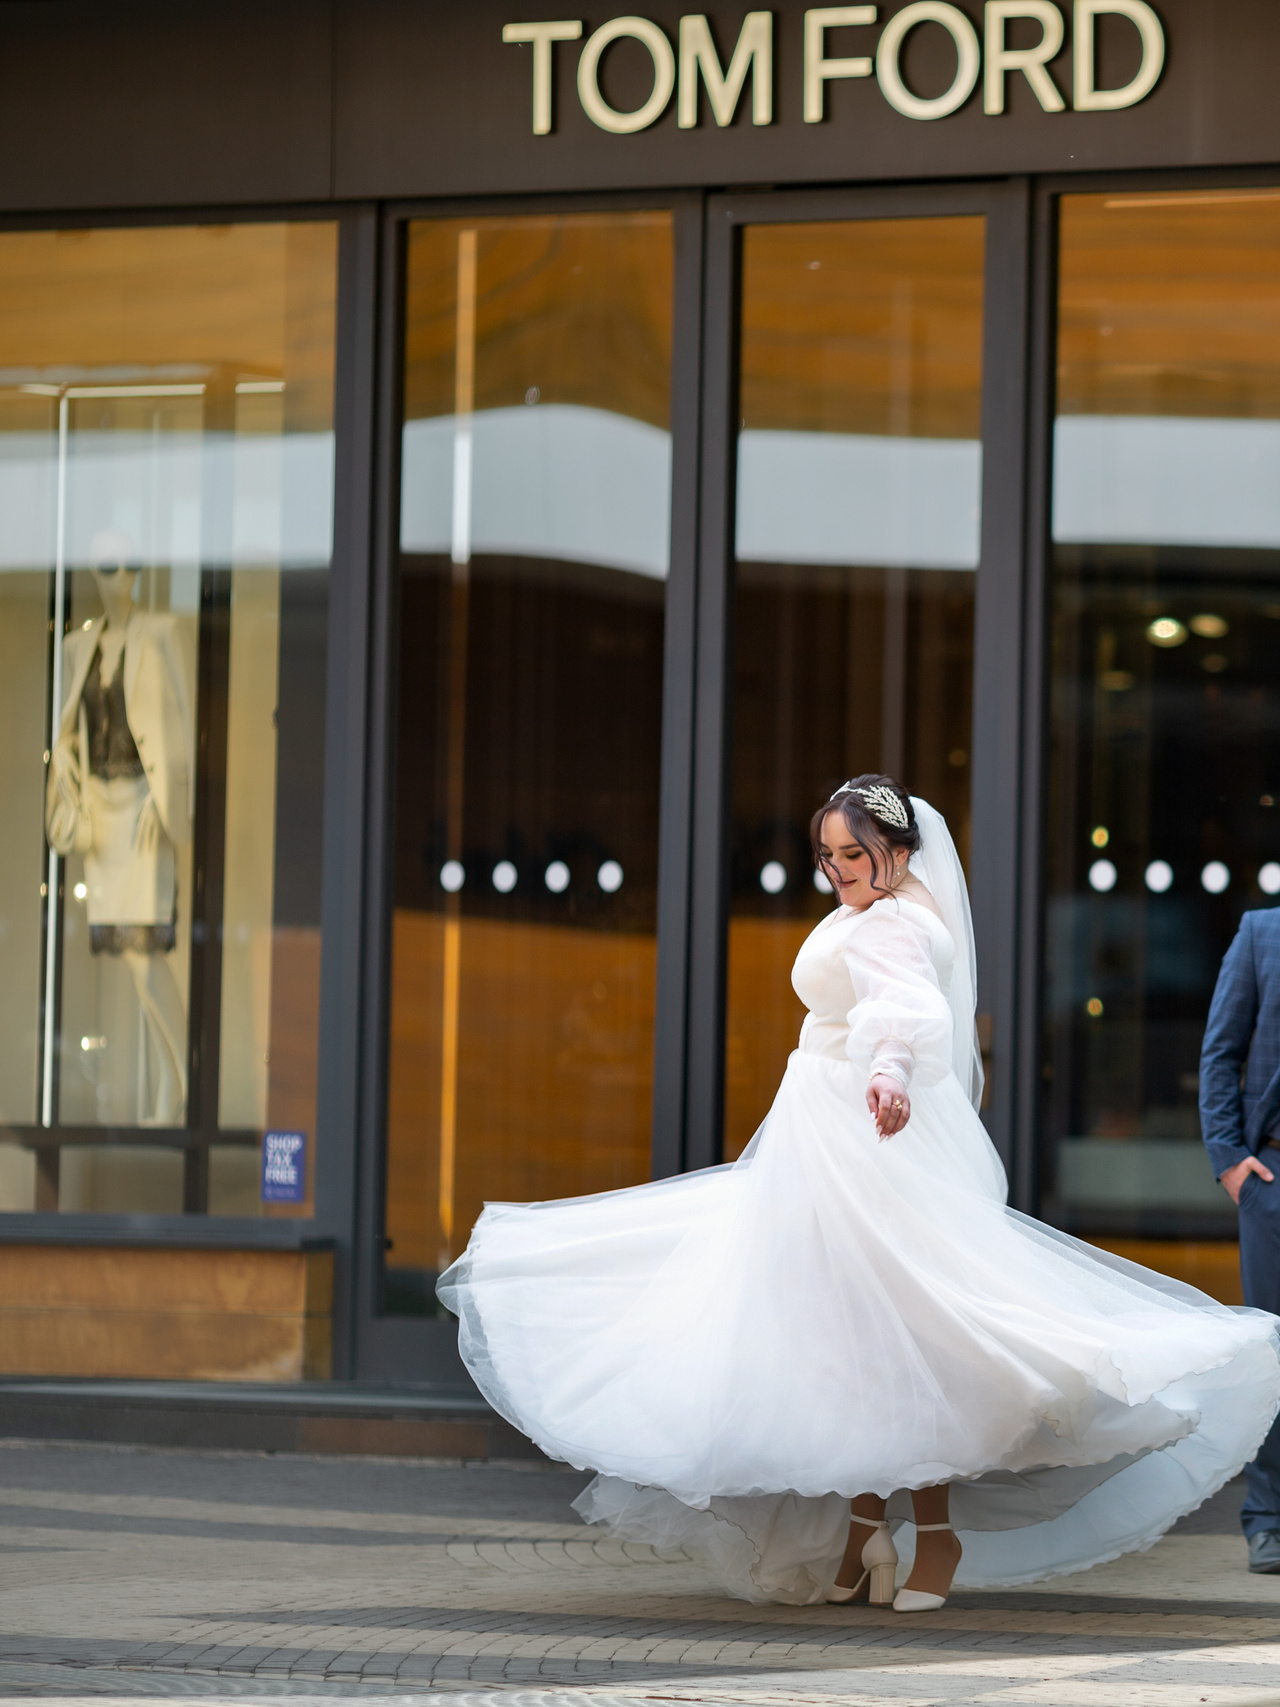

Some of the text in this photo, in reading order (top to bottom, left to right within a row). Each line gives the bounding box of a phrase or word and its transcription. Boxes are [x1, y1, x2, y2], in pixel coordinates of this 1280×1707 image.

[502, 0, 1166, 136] TOM FORD
[266, 1133, 303, 1153] SHOP
[266, 1150, 293, 1167] TAX
[265, 1166, 298, 1185] FREE
